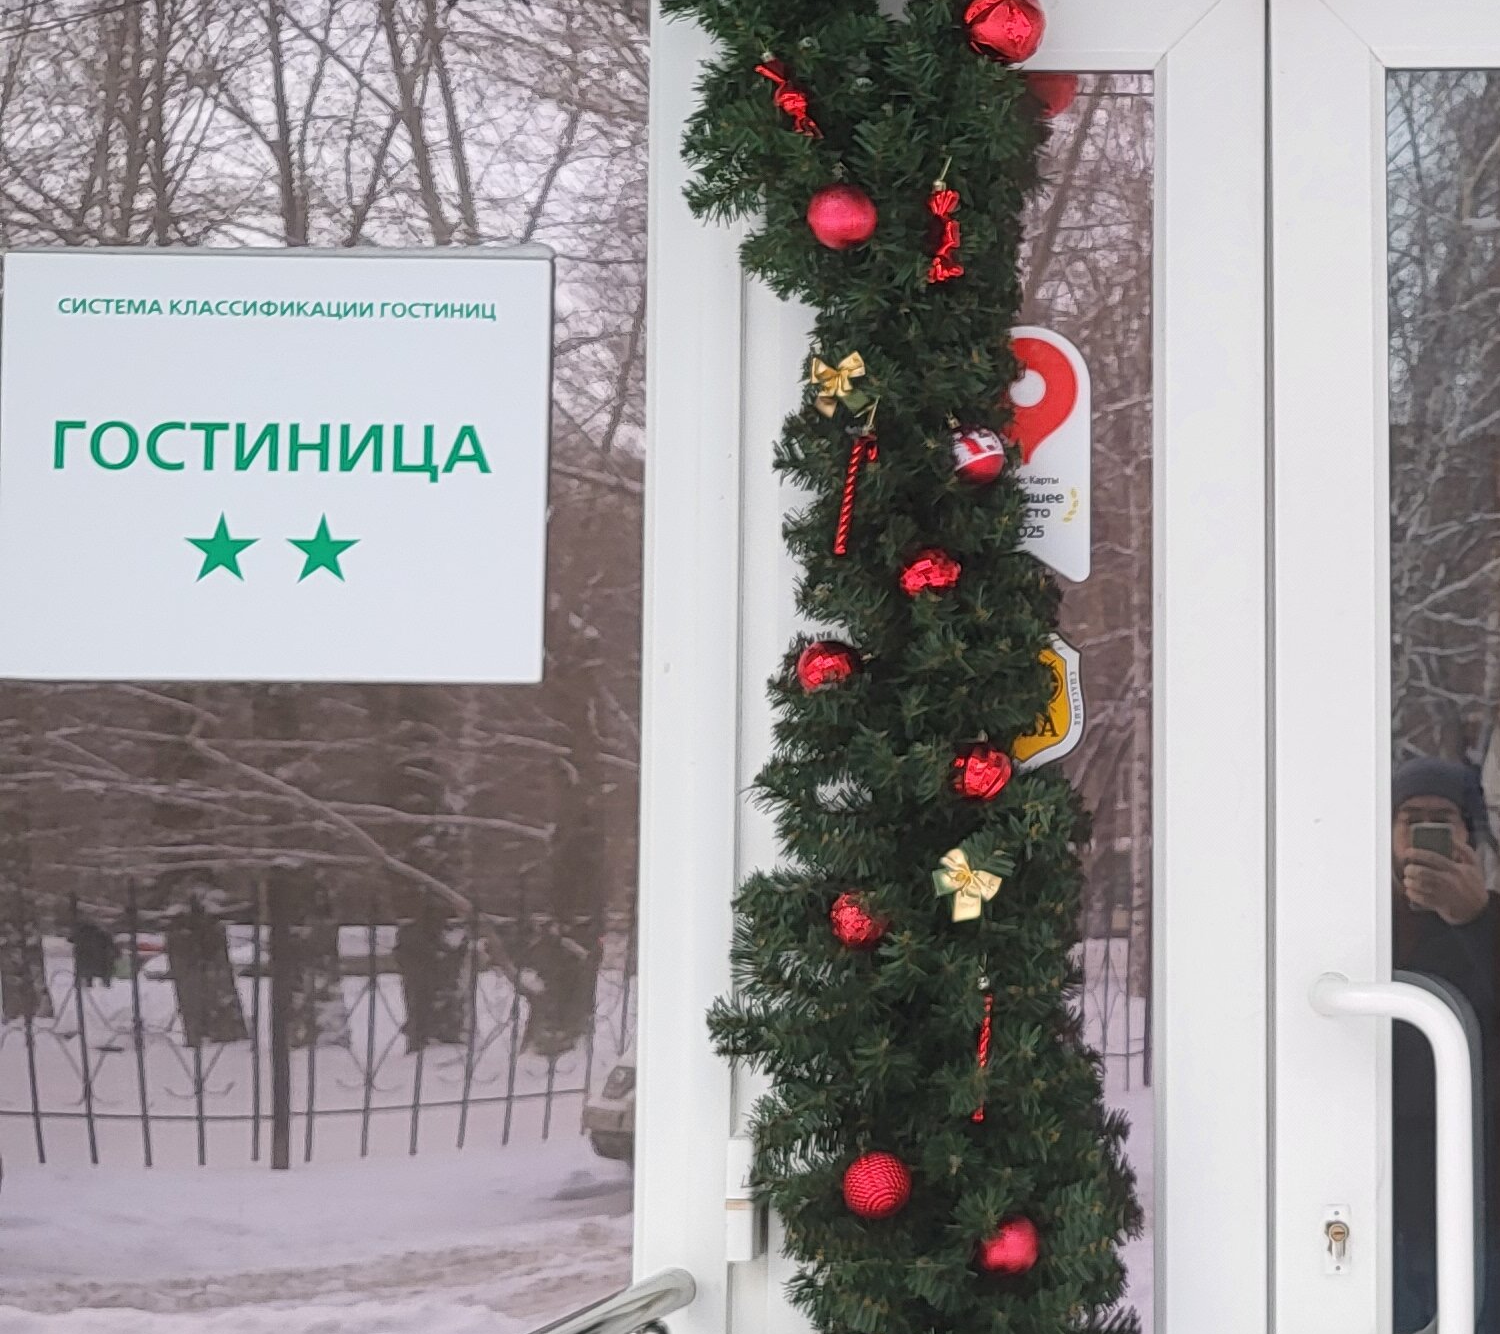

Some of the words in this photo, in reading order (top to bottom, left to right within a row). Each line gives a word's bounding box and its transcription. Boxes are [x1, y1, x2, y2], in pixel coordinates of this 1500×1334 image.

[58, 297, 163, 316] СИСТЕМА
[169, 299, 374, 320] КЛАССИФИКАЦИИ
[380, 301, 497, 321] ГОСТИНИЦ
[53, 420, 492, 483] ГОСТИНИЦА
[1016, 525, 1045, 539] 025
